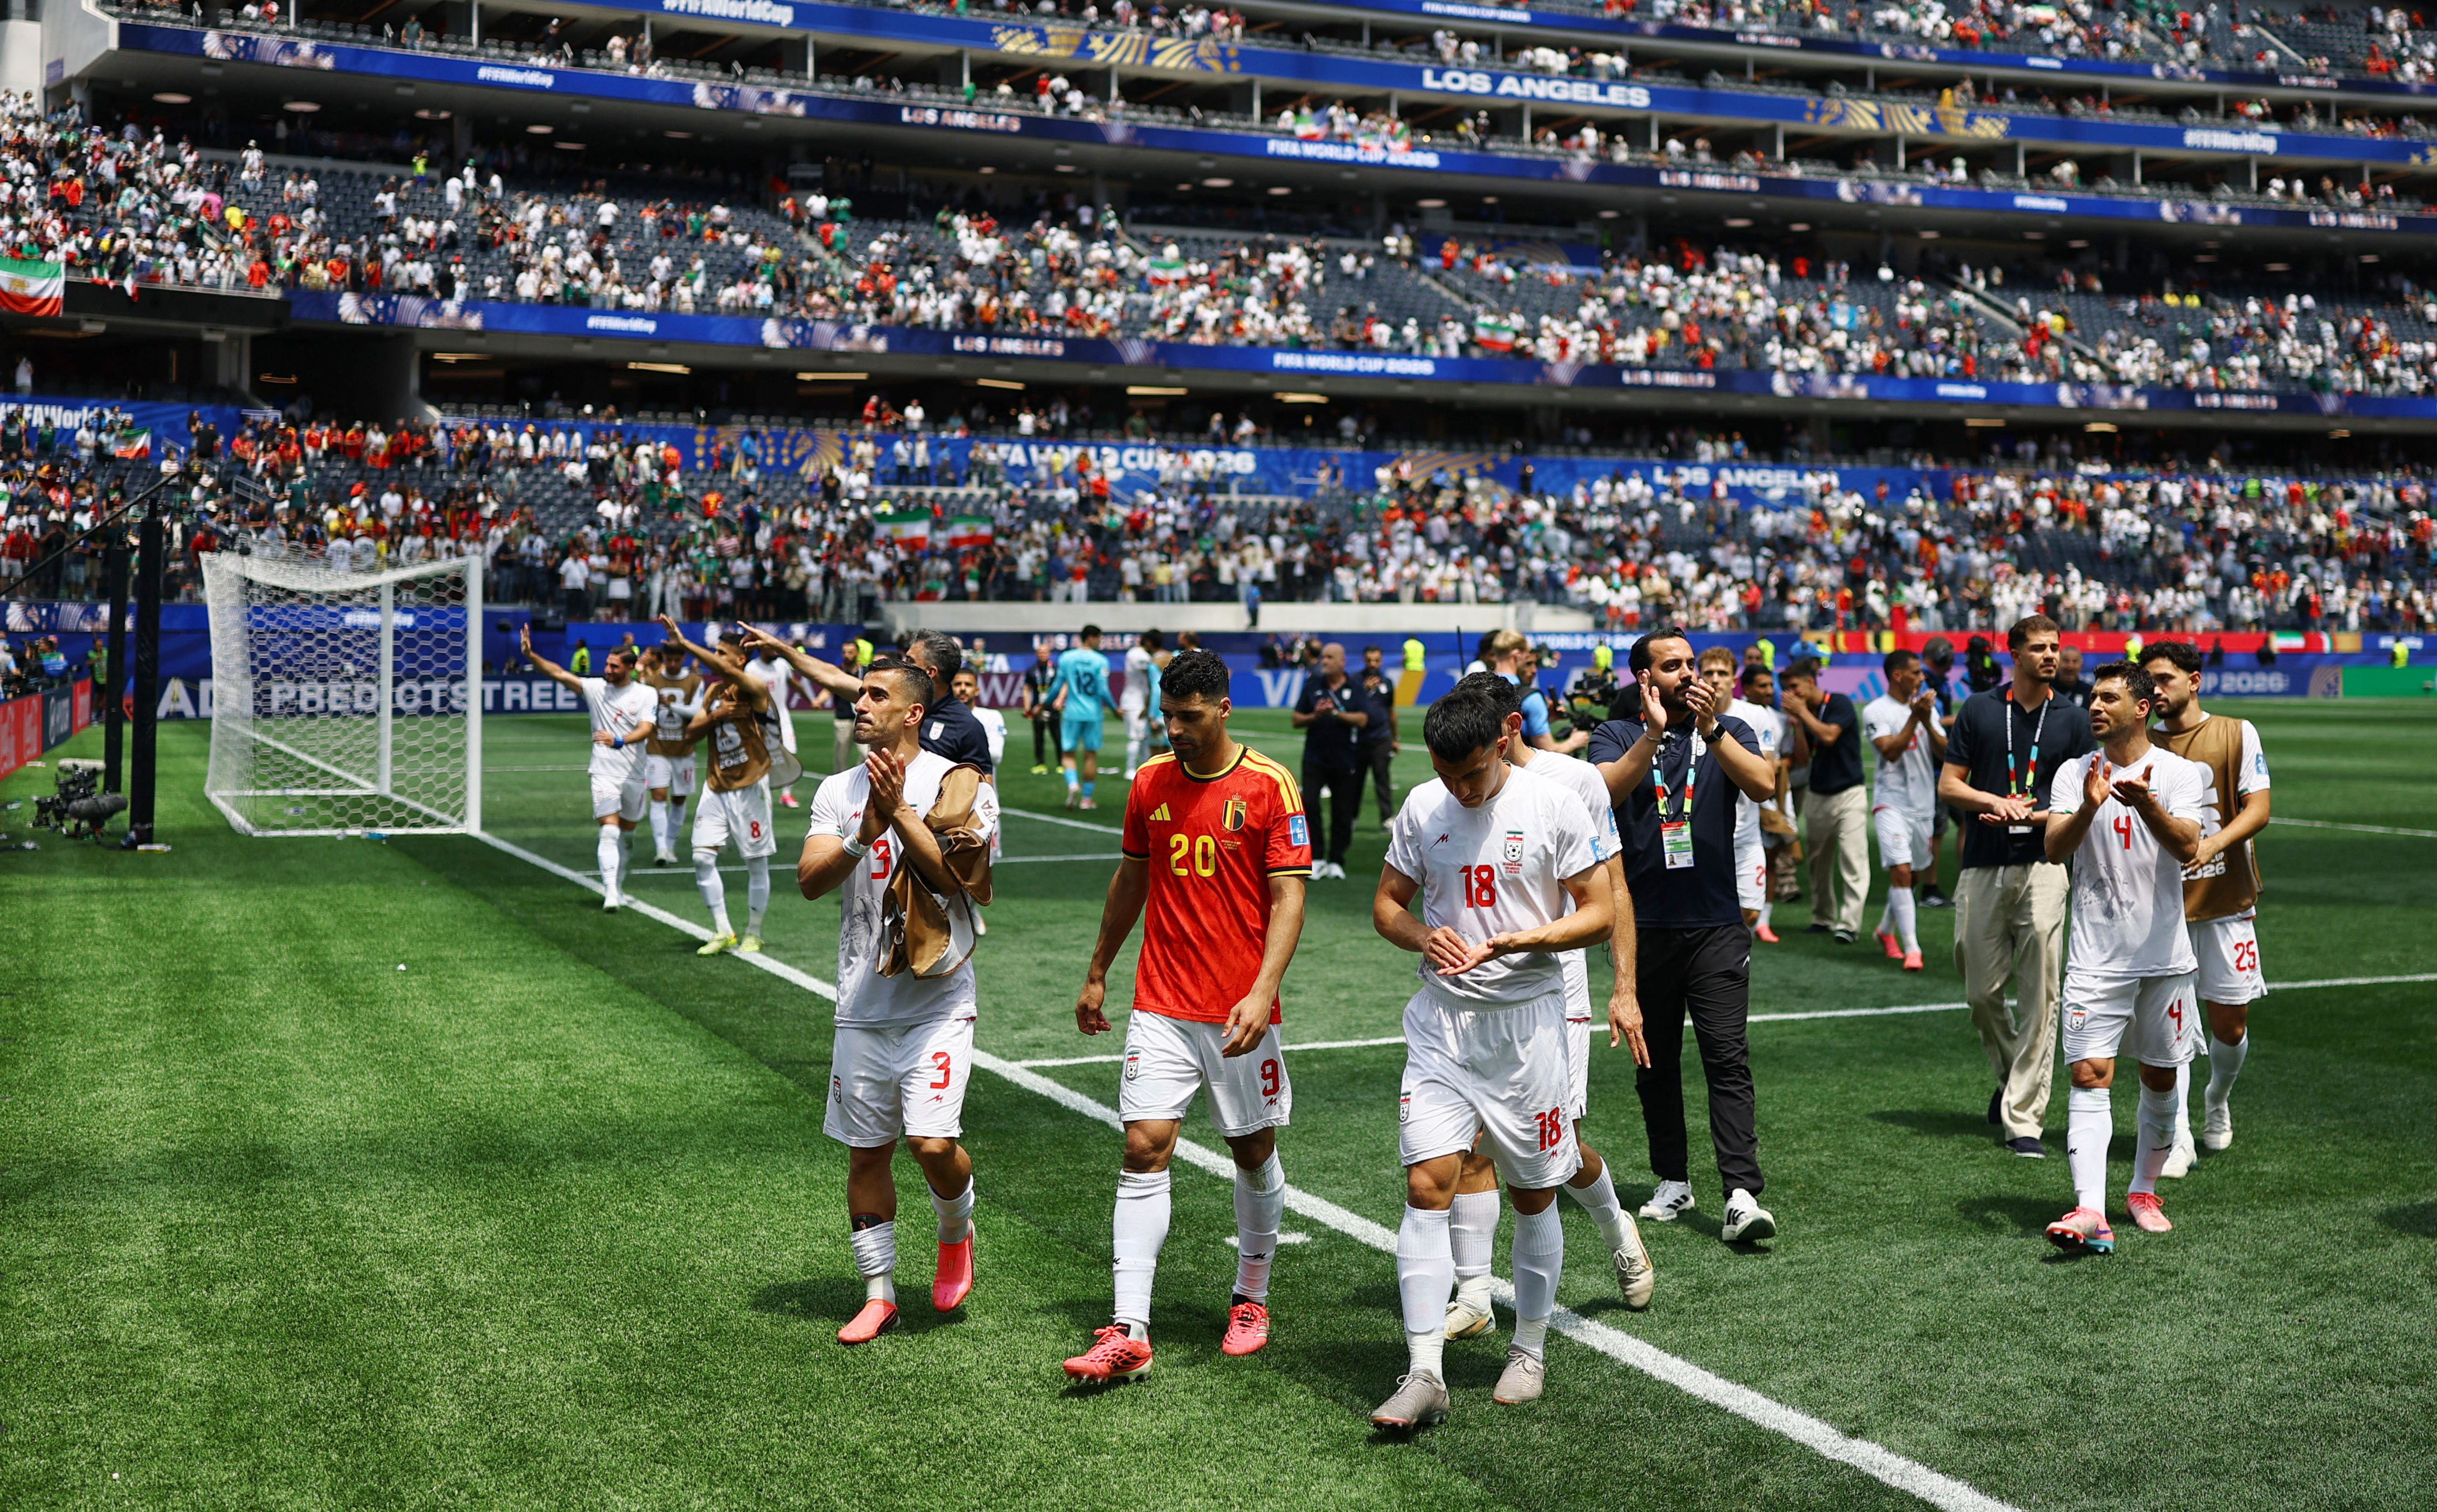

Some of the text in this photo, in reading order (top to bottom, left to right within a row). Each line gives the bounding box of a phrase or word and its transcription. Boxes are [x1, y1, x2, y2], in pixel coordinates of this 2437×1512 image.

[1422, 68, 1651, 108] LOS ANGELES
[902, 107, 1021, 132] LOS ANGELES
[1267, 139, 1300, 157] FIFA
[1302, 141, 1356, 161] WORLD
[953, 335, 1065, 356] LOS ANGELES
[1273, 352, 1304, 368] FIFA
[1305, 354, 1356, 371] WORLD
[1356, 356, 1385, 372] CUP
[2221, 671, 2285, 693] 2026
[751, 821, 761, 839] 8
[2113, 815, 2131, 850] 4
[871, 840, 891, 879] 3
[1170, 834, 1216, 877] 20
[1459, 865, 1496, 908] 18
[2234, 940, 2256, 972] 25
[2168, 999, 2182, 1031] 4
[930, 1052, 952, 1089] 3
[1261, 1059, 1279, 1096] 9
[1533, 1107, 1562, 1152] 18
